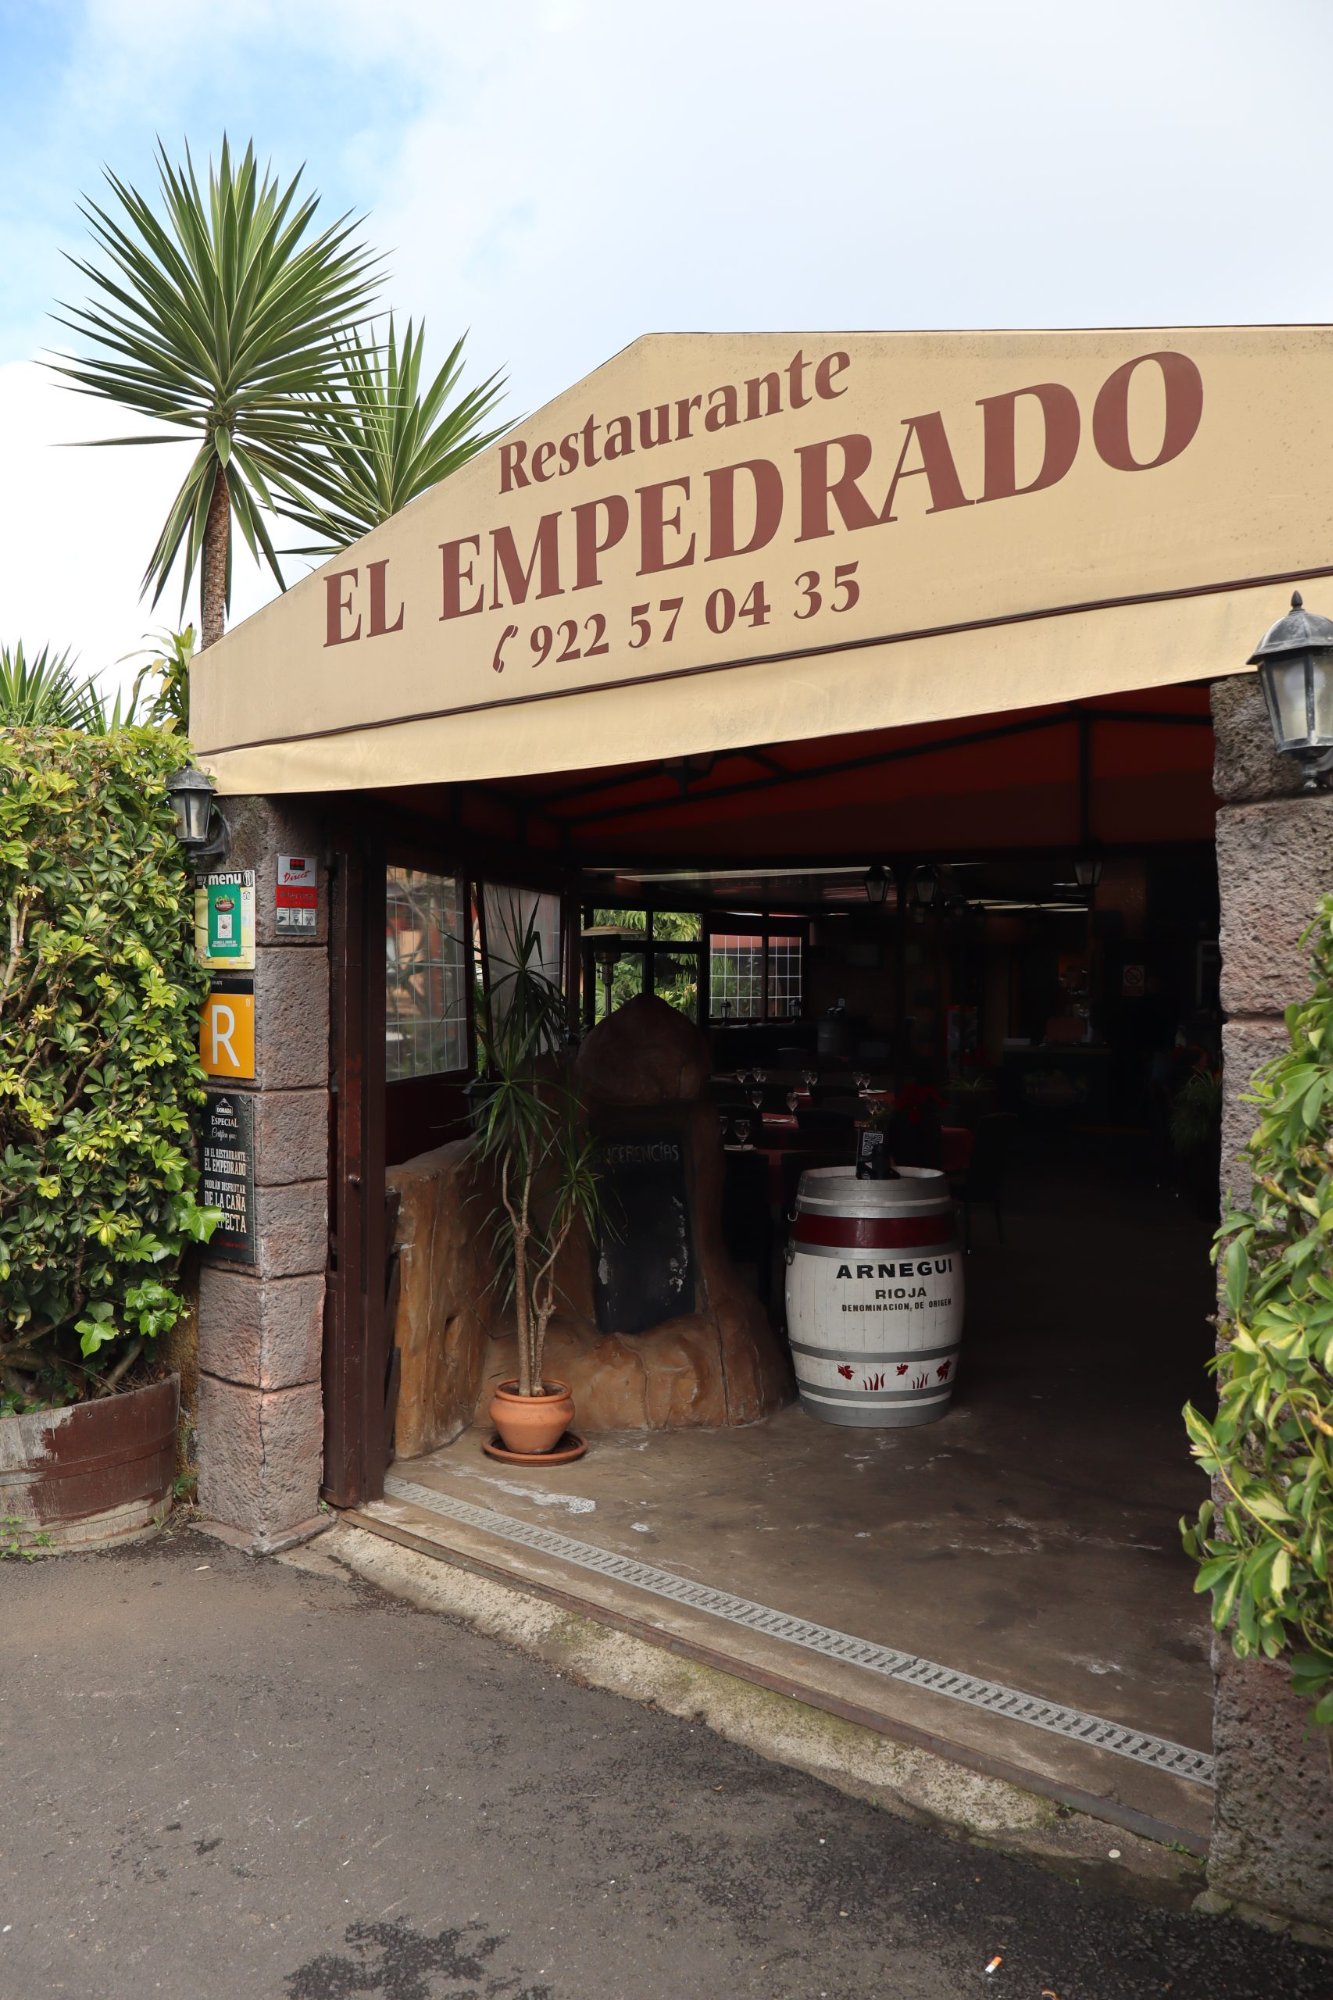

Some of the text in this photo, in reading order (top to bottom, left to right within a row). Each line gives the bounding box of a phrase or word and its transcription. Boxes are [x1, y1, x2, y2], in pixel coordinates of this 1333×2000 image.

[499, 350, 850, 494] Restaurante
[324, 352, 1203, 648] EL EMPEDRADO
[530, 561, 860, 670] 922 57 04 35
[208, 873, 242, 886] menu
[211, 1004, 241, 1067] R
[211, 1115, 239, 1128] ESPECIAL
[204, 1157, 246, 1177] EL EMPEDRADO
[204, 1190, 247, 1212] DE LA CAÑA
[836, 1258, 953, 1279] ARNEGUI
[875, 1287, 927, 1300] RIOJA
[914, 1301, 924, 1310] DE
[928, 1298, 952, 1308] ORIGEN
